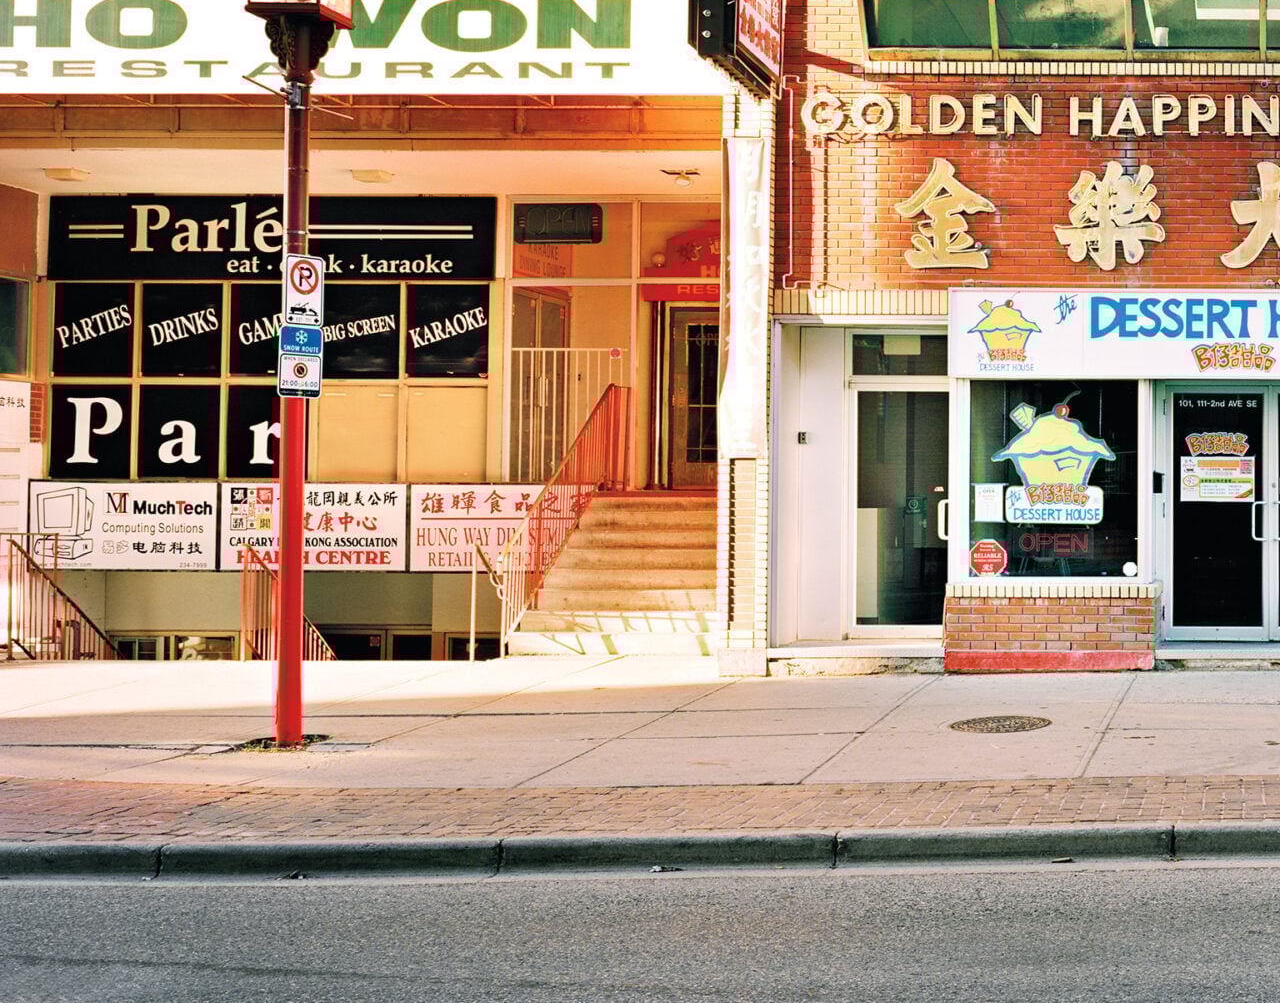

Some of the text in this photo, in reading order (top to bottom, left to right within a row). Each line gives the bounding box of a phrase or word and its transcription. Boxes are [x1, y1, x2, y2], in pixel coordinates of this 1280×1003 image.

[0, 61, 631, 79] RESTAURANT
[801, 93, 1043, 137] GOLDEN
[131, 202, 283, 253] Parlé
[227, 257, 260, 273] eat
[361, 254, 453, 274] karaoke
[701, 265, 720, 278] H
[1054, 293, 1080, 325] the
[1090, 296, 1261, 339] DESSERT
[56, 303, 133, 348] PARTIES
[148, 308, 219, 346] DRINKS
[323, 314, 397, 342] BIG SCREEN
[409, 307, 488, 348] KARAOKE
[283, 344, 319, 353] SNOW ROUTE
[979, 363, 1035, 372] DESSERT HOUSE
[1178, 399, 1258, 409] 101, 111-2nd AVE SE
[303, 490, 398, 506] 龍岡親義公所
[133, 500, 213, 515] MuchTech
[1014, 508, 1100, 521] DESSERT HOUSE
[102, 522, 204, 534] Computing Solutions
[416, 527, 458, 546] HUNG
[463, 527, 491, 546] WAY
[229, 537, 274, 547] CALGARY
[305, 537, 331, 547] KONG
[333, 537, 398, 548] ASSOCIATION
[1019, 533, 1088, 552] OPEN
[315, 550, 391, 565] CENTRE
